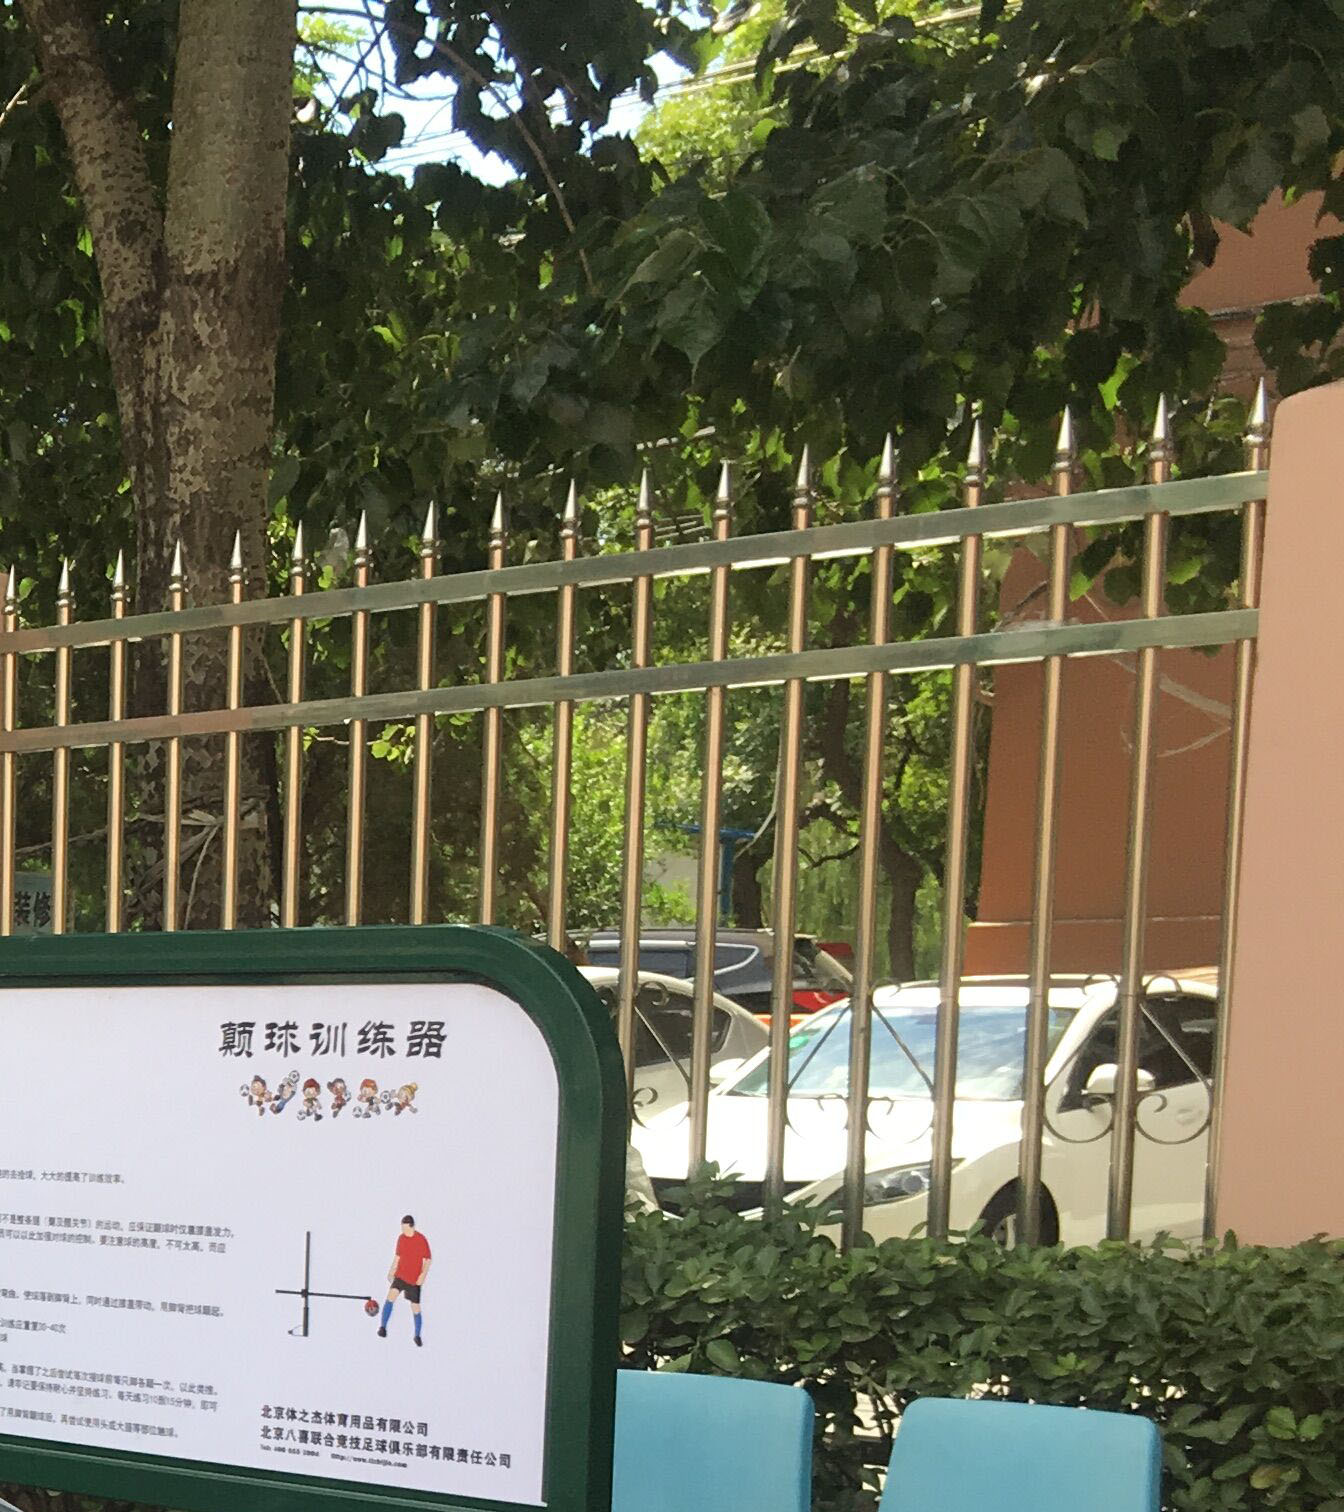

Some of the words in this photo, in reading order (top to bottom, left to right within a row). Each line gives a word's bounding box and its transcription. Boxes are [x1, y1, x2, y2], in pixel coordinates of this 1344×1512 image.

[218, 1020, 448, 1059] 颠球训练器
[261, 1405, 429, 1437] 北京体之杰体育用品有限公司
[260, 1425, 512, 1468] 北京八喜联合竞技足球俱乐部有限责任公司
